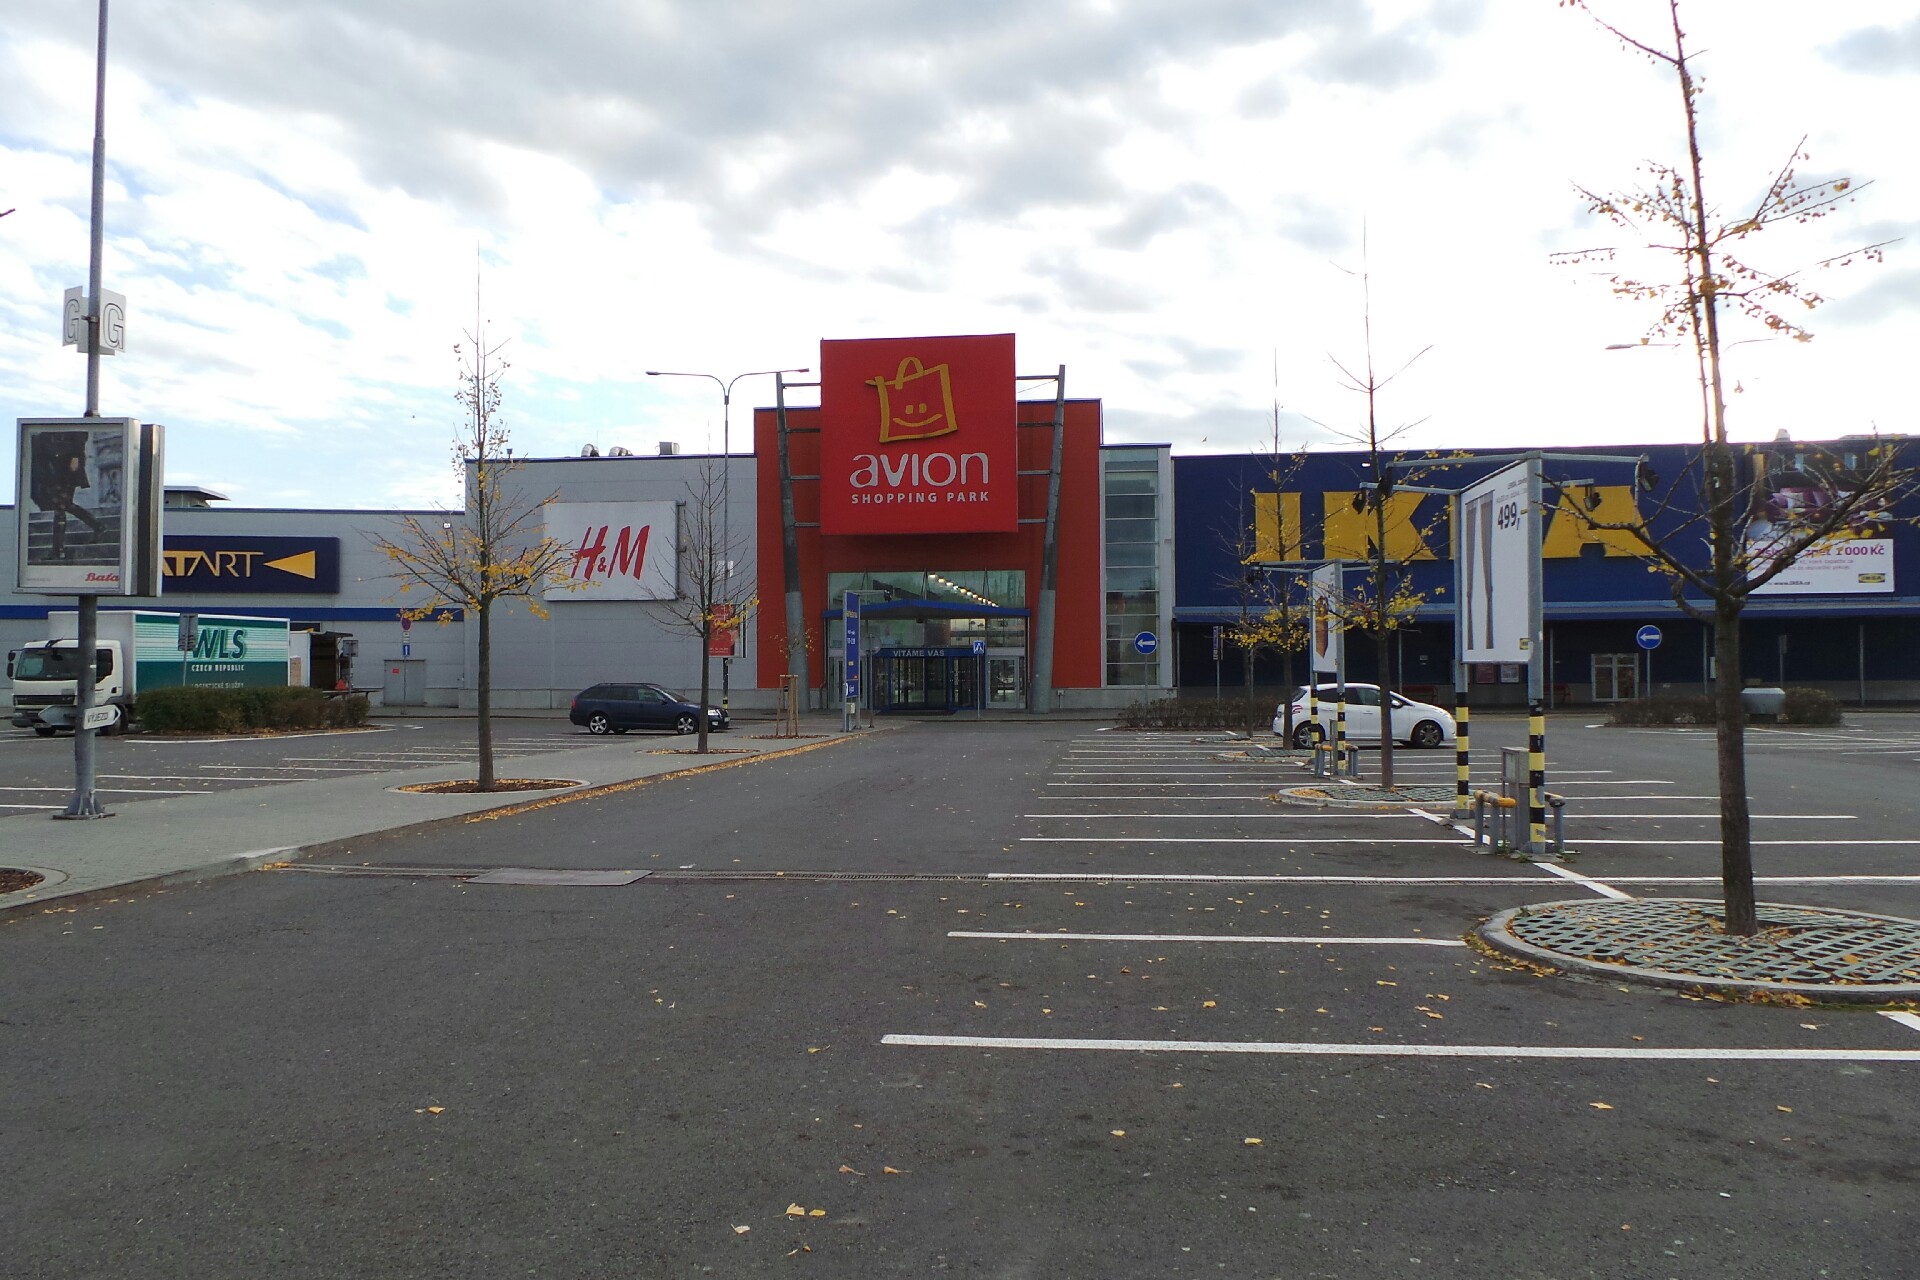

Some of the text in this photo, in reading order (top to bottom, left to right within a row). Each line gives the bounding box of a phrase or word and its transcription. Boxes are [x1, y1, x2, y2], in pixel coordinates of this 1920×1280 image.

[64, 298, 80, 344] G
[103, 302, 124, 349] G
[849, 452, 989, 488] avion
[851, 491, 989, 504] SHOPPING PARK
[1253, 484, 1662, 562] IKA
[570, 524, 650, 581] H&M
[192, 628, 245, 659] WLS
[191, 664, 245, 672] CZECH REPUBLIC
